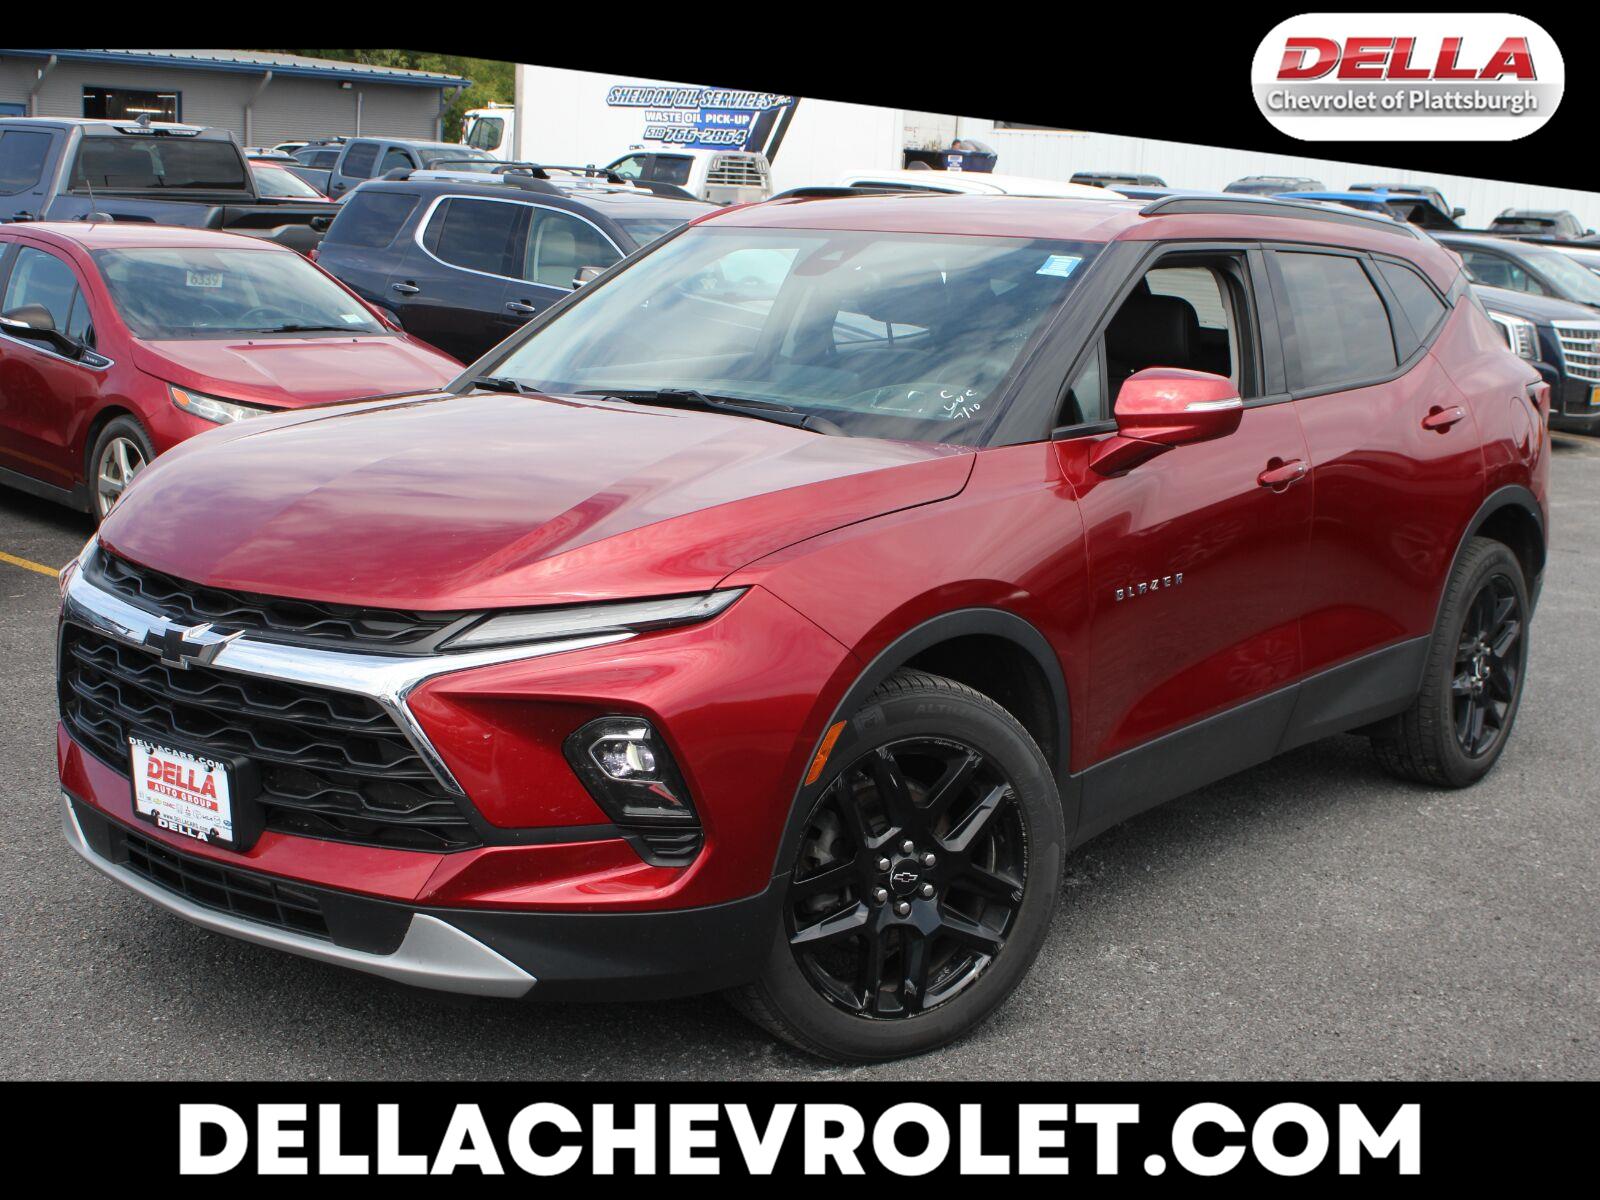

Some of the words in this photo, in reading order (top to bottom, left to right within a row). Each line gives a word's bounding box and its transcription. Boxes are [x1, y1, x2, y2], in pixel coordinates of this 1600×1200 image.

[608, 86, 675, 107] SHELDON
[674, 88, 701, 107] OIL
[700, 89, 775, 110] SERVICES
[645, 111, 682, 123] WASTE
[684, 112, 702, 124] OIL
[705, 114, 750, 125] PICK-UP
[1115, 572, 1184, 602] BLAZER
[146, 756, 217, 799] DELLA
[153, 782, 178, 798] AUTO
[180, 792, 213, 809] GROUP
[157, 818, 209, 842] DELLA
